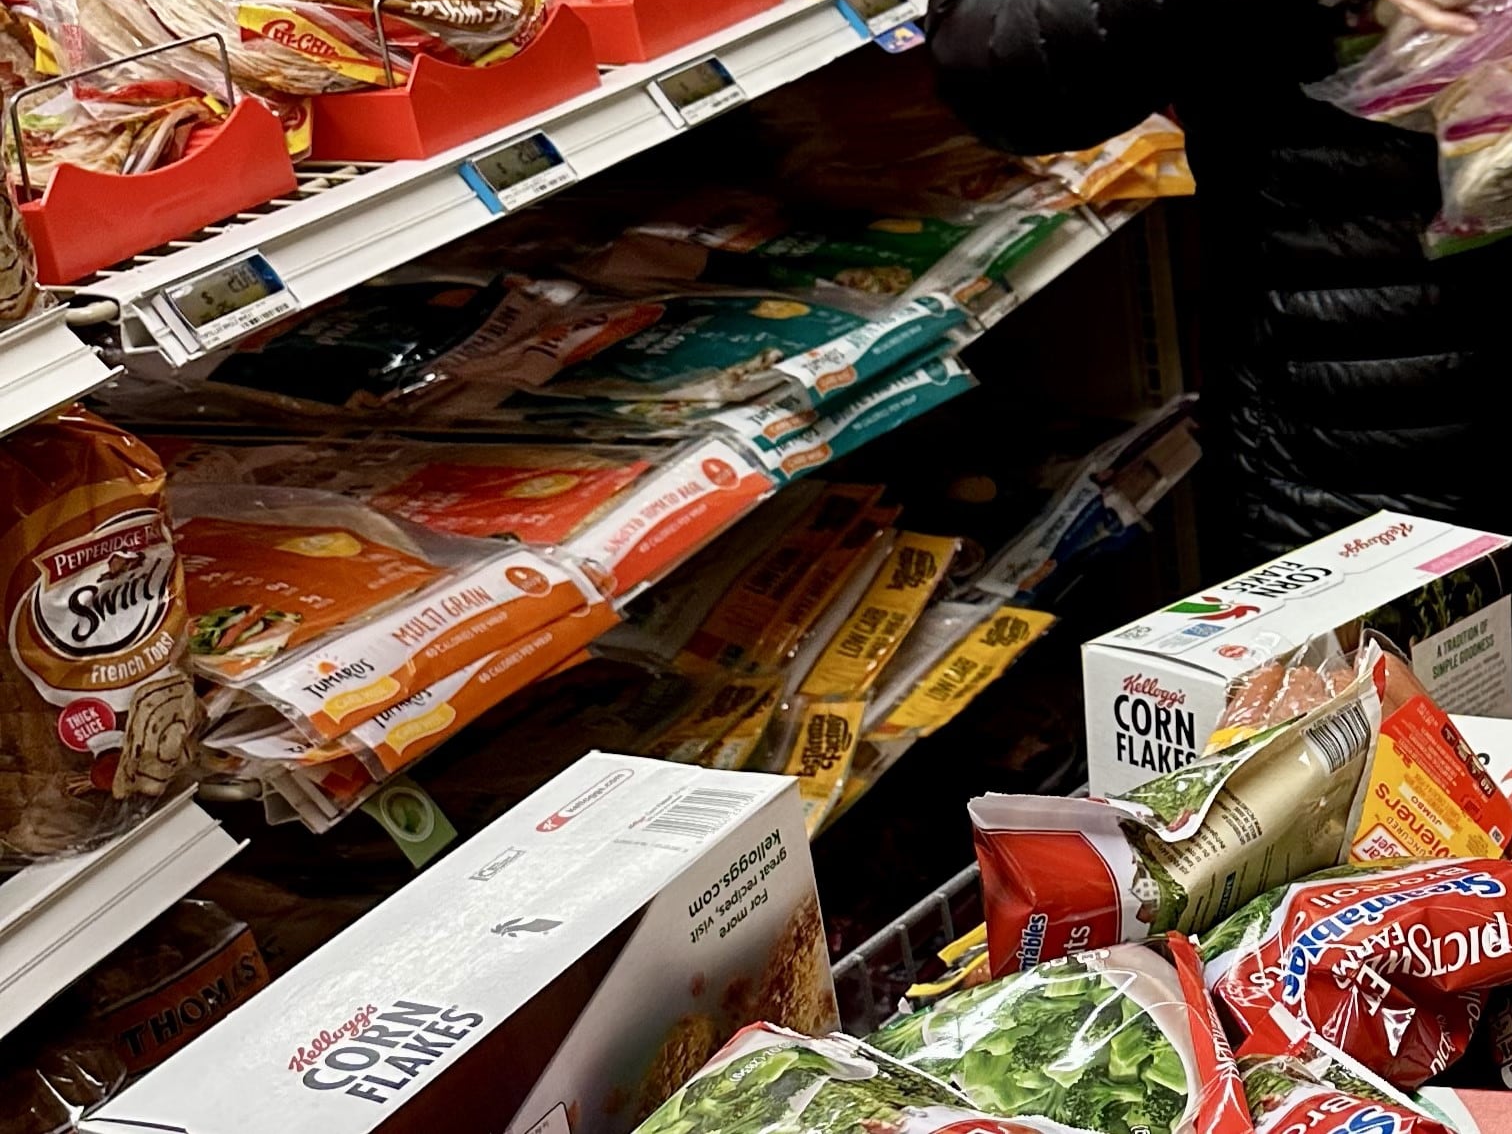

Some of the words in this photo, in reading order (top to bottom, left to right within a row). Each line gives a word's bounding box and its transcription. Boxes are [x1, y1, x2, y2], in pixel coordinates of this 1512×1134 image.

[54, 536, 141, 576] PEPPERIDGE
[1339, 522, 1414, 559] Kellogg's
[1222, 560, 1303, 594] FLAKES
[1254, 563, 1333, 599] CORN
[69, 558, 162, 642] Swirl
[392, 607, 445, 646] MULTI
[442, 586, 494, 617] GRAIN
[837, 636, 863, 658] LOW
[861, 607, 889, 637] CARB
[1436, 643, 1443, 658] A
[1443, 627, 1478, 654] TRADITION
[1479, 619, 1489, 635] OF
[1460, 636, 1495, 666] GOODNESS
[91, 653, 145, 683] French
[147, 632, 175, 663] Toast
[302, 658, 375, 700] TUMAROS
[924, 675, 953, 702] LOW
[946, 656, 978, 683] CARB
[1123, 673, 1186, 708] Kellogg's
[66, 707, 99, 731] THICK
[74, 719, 106, 741] SLICE
[1114, 695, 1195, 750] CORN
[1410, 796, 1443, 826] JUMBO
[688, 829, 783, 918] kelloggs.com
[762, 848, 788, 882] great
[716, 876, 759, 913] recipes,
[750, 889, 770, 912] For
[690, 915, 715, 944] visit
[719, 909, 749, 940] more
[289, 1004, 378, 1072] Kellogg's
[302, 1000, 443, 1090] CORN
[345, 1007, 484, 1103] FLAKES
